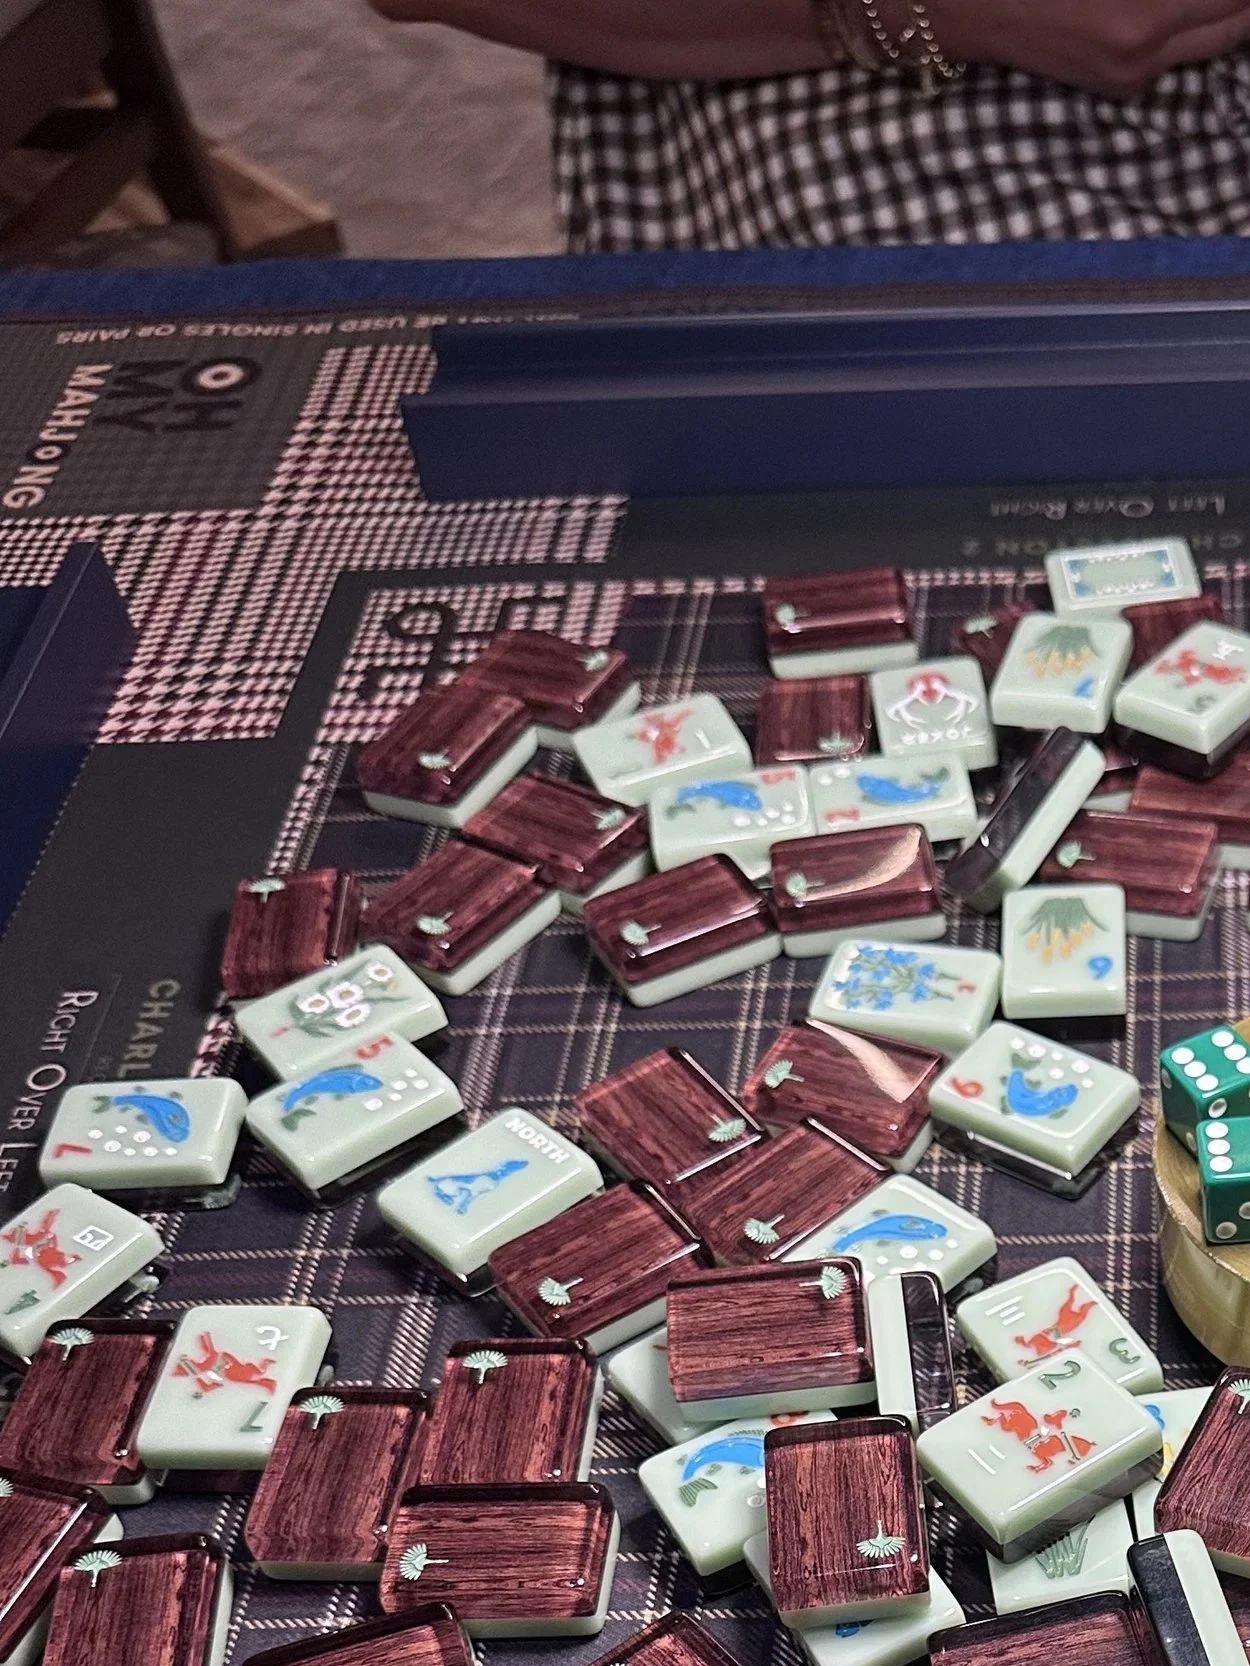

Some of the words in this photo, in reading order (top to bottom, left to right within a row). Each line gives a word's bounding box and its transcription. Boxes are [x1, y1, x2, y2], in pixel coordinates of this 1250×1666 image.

[56, 326, 130, 345] PAIRS
[136, 323, 176, 340] OR
[184, 322, 298, 338] SINGLES
[304, 321, 332, 335] IN
[338, 316, 407, 333] USED
[40, 990, 99, 1054] RIGHT
[355, 1037, 393, 1061] 5
[7, 1063, 67, 1132] OVER
[503, 1116, 571, 1166] NORTH
[1108, 1336, 1142, 1365] 3
[1039, 1357, 1082, 1391] 2
[239, 1402, 270, 1434] 7
